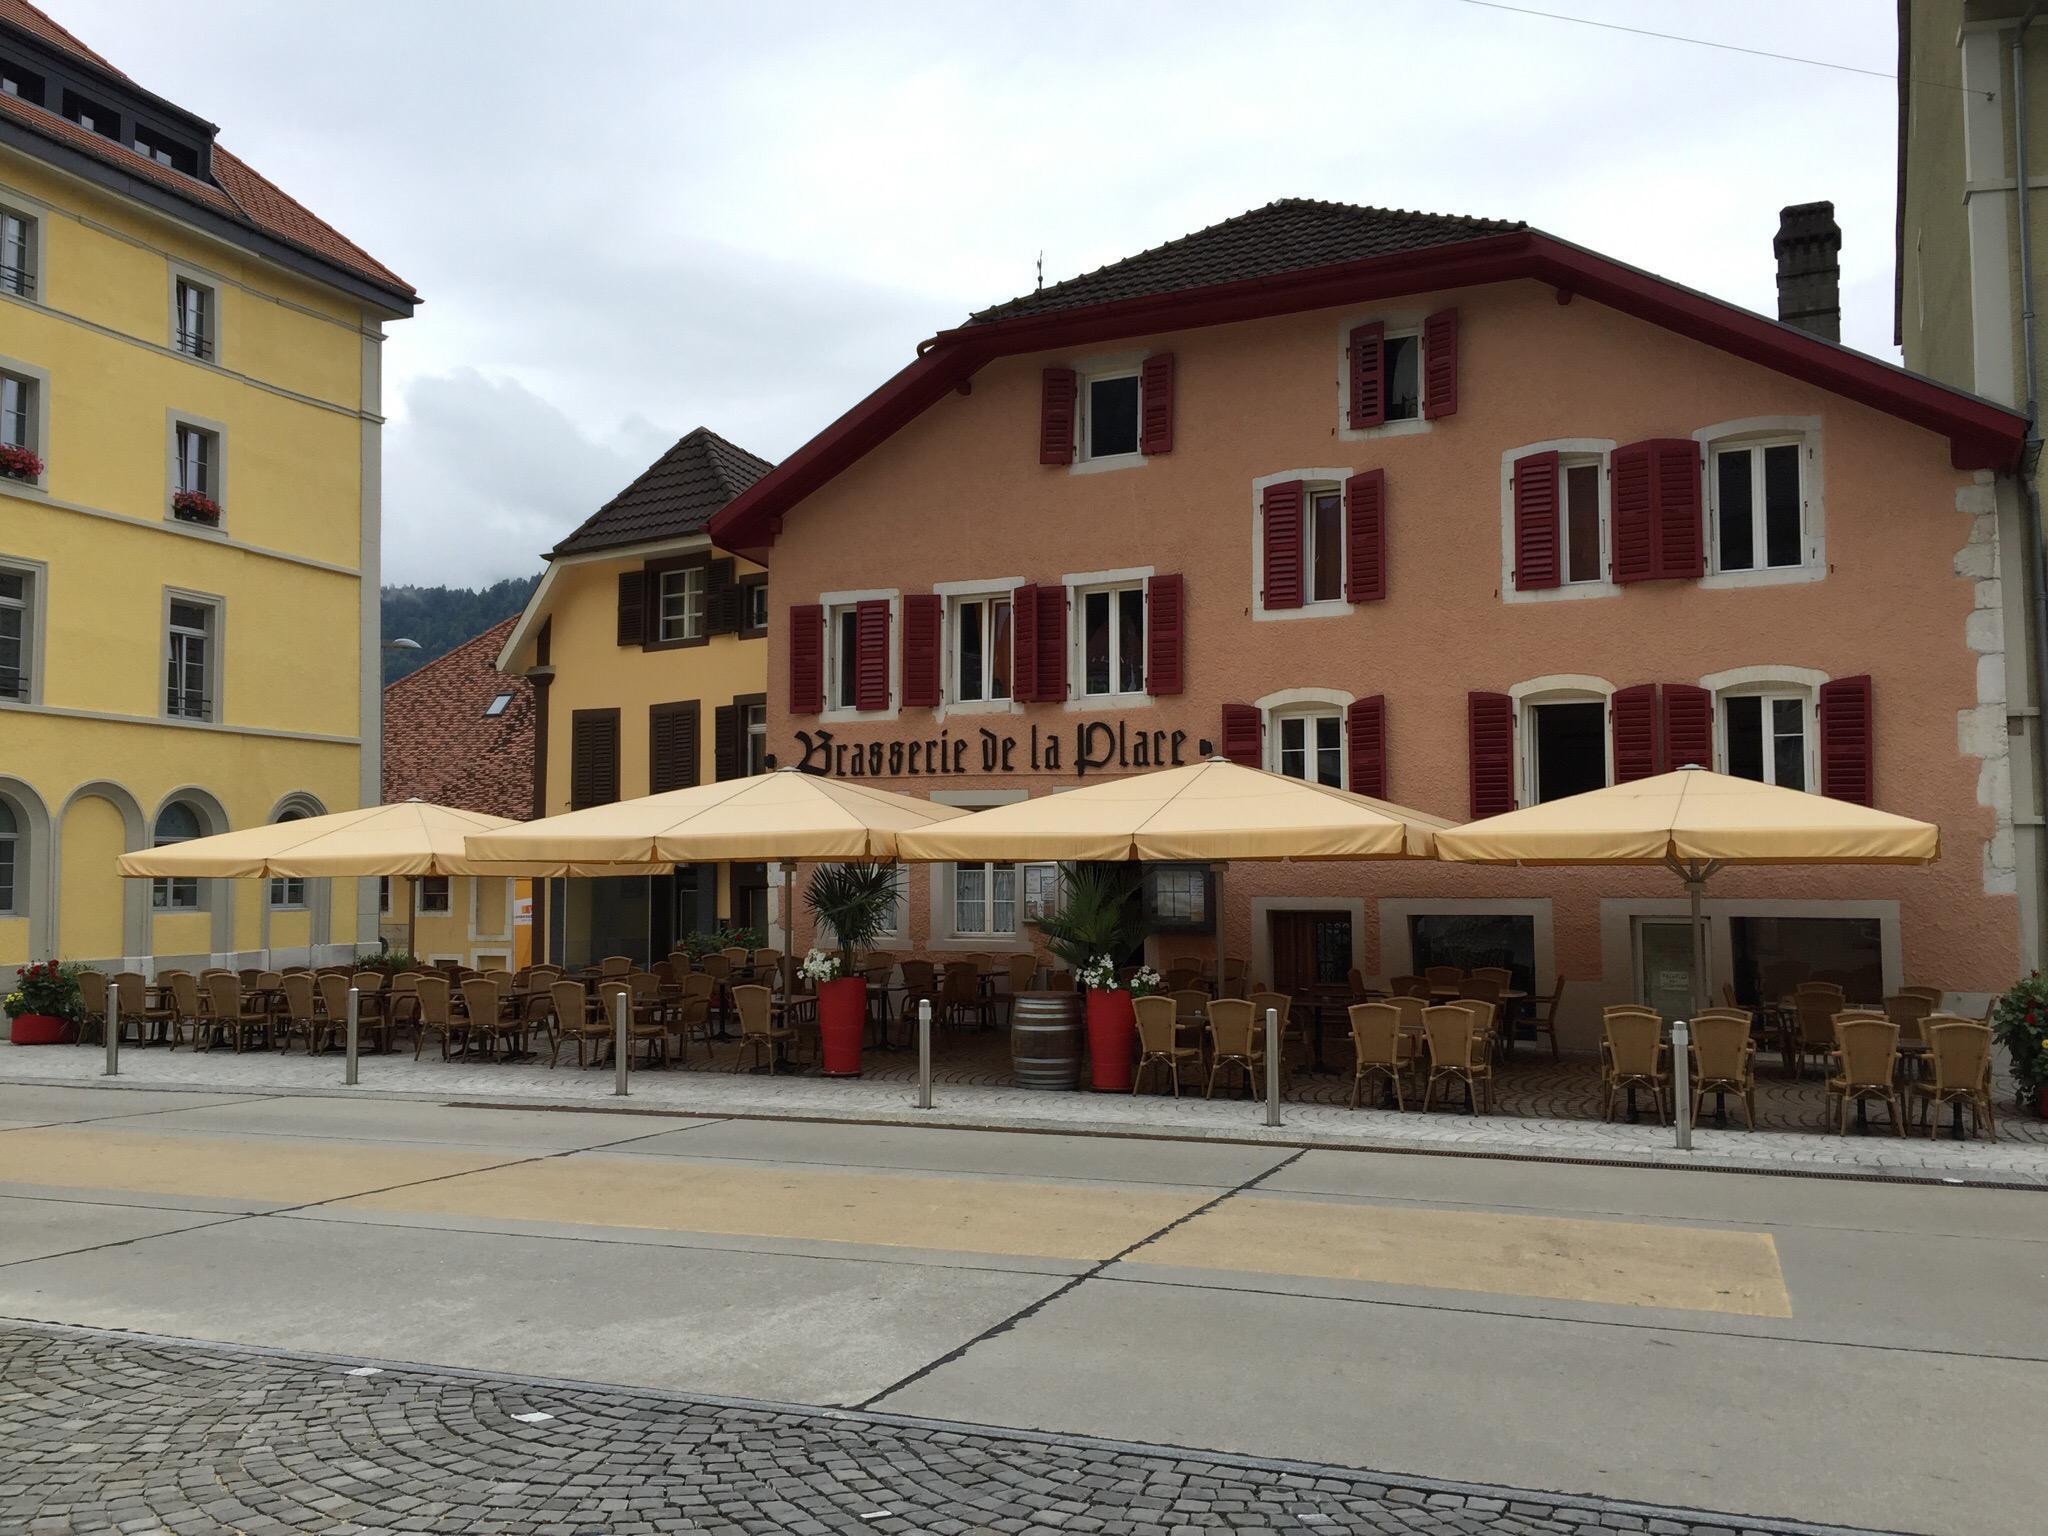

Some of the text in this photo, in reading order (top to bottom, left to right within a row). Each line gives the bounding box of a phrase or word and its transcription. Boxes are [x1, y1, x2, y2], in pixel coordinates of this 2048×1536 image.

[794, 720, 1187, 777] Brasserie de la Place
